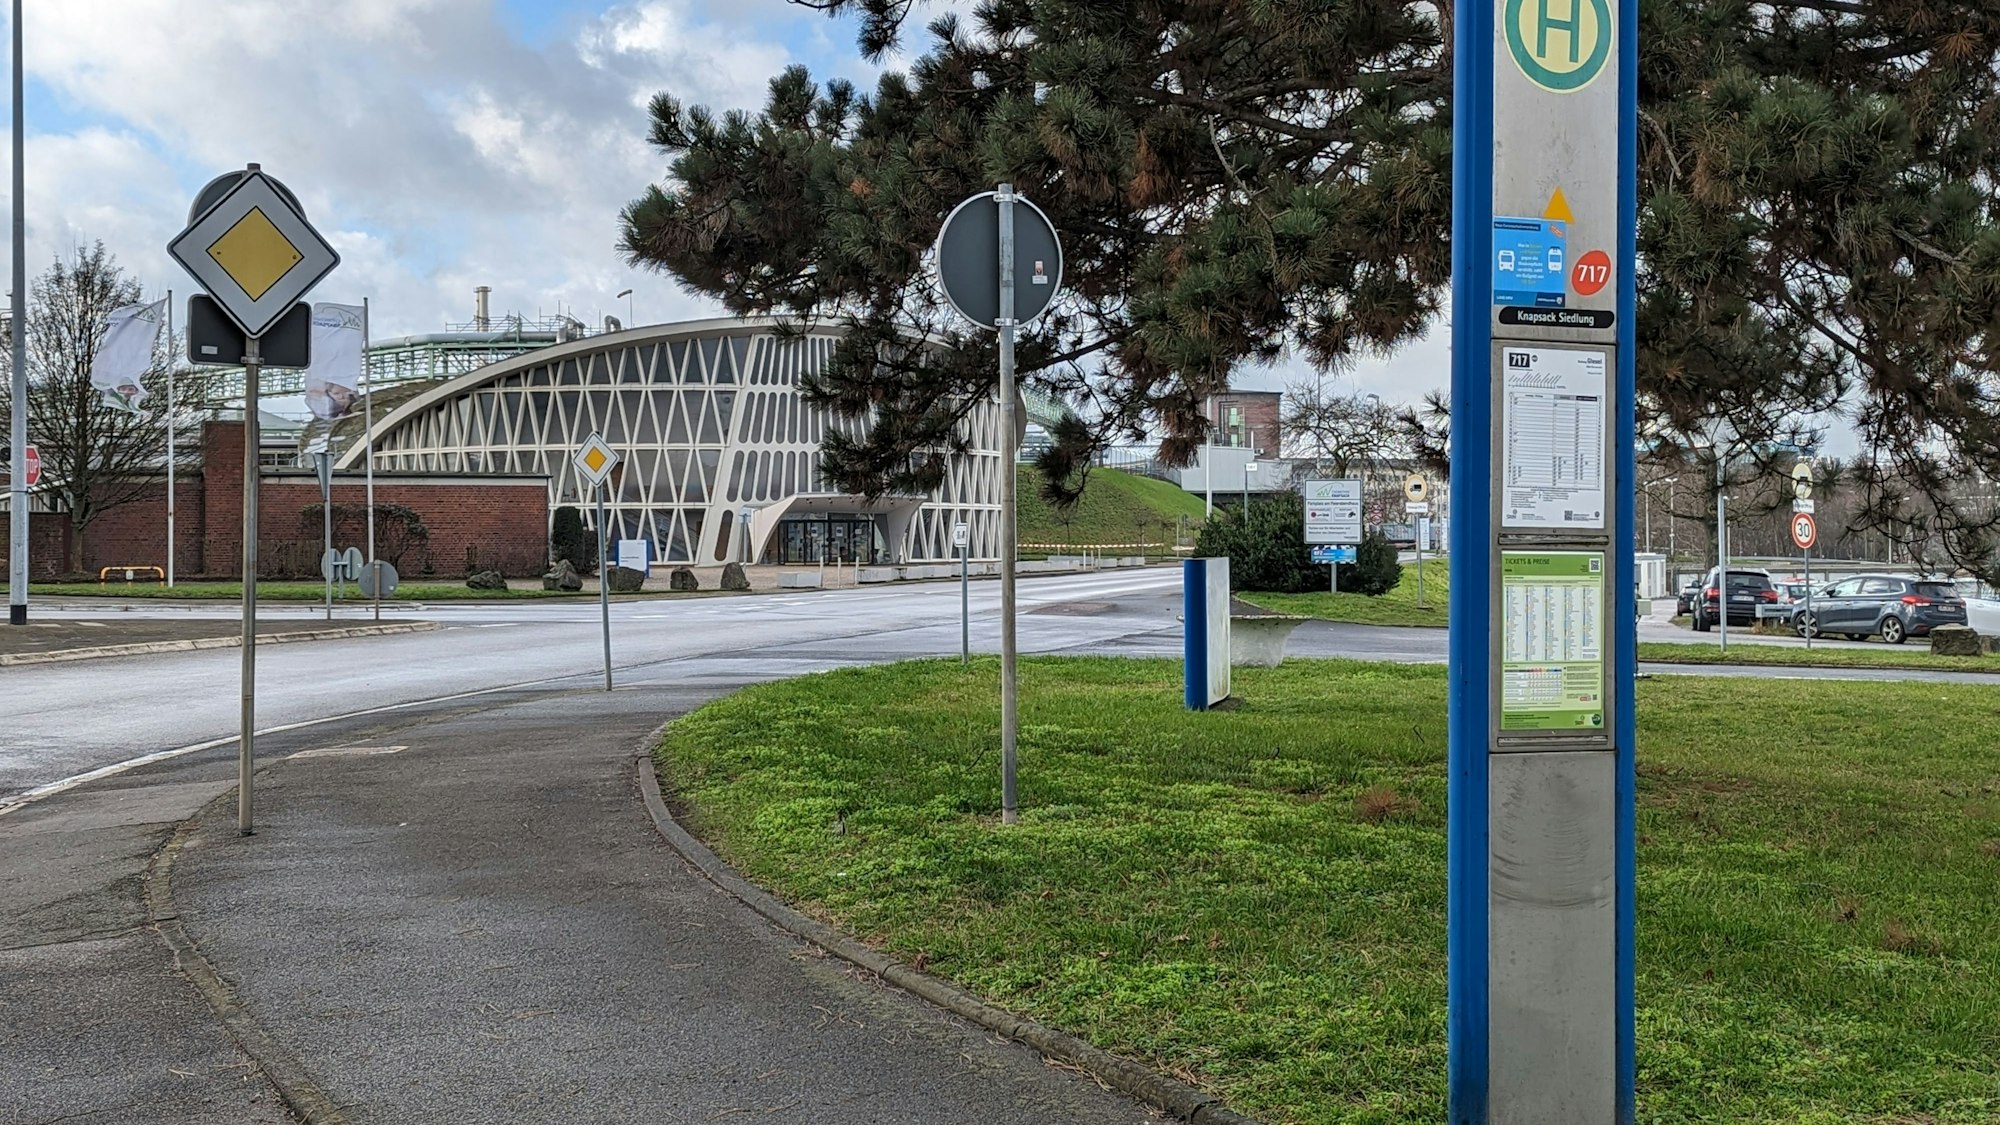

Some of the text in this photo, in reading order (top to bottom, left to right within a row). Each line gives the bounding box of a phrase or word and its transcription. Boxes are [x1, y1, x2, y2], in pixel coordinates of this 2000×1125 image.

[1536, 0, 1581, 63] H
[1577, 264, 1607, 283] 717
[1517, 310, 1595, 327] Knapsack Siedlung
[1510, 354, 1529, 367] 717
[25, 459, 38, 474] TOP
[1797, 522, 1810, 538] 30
